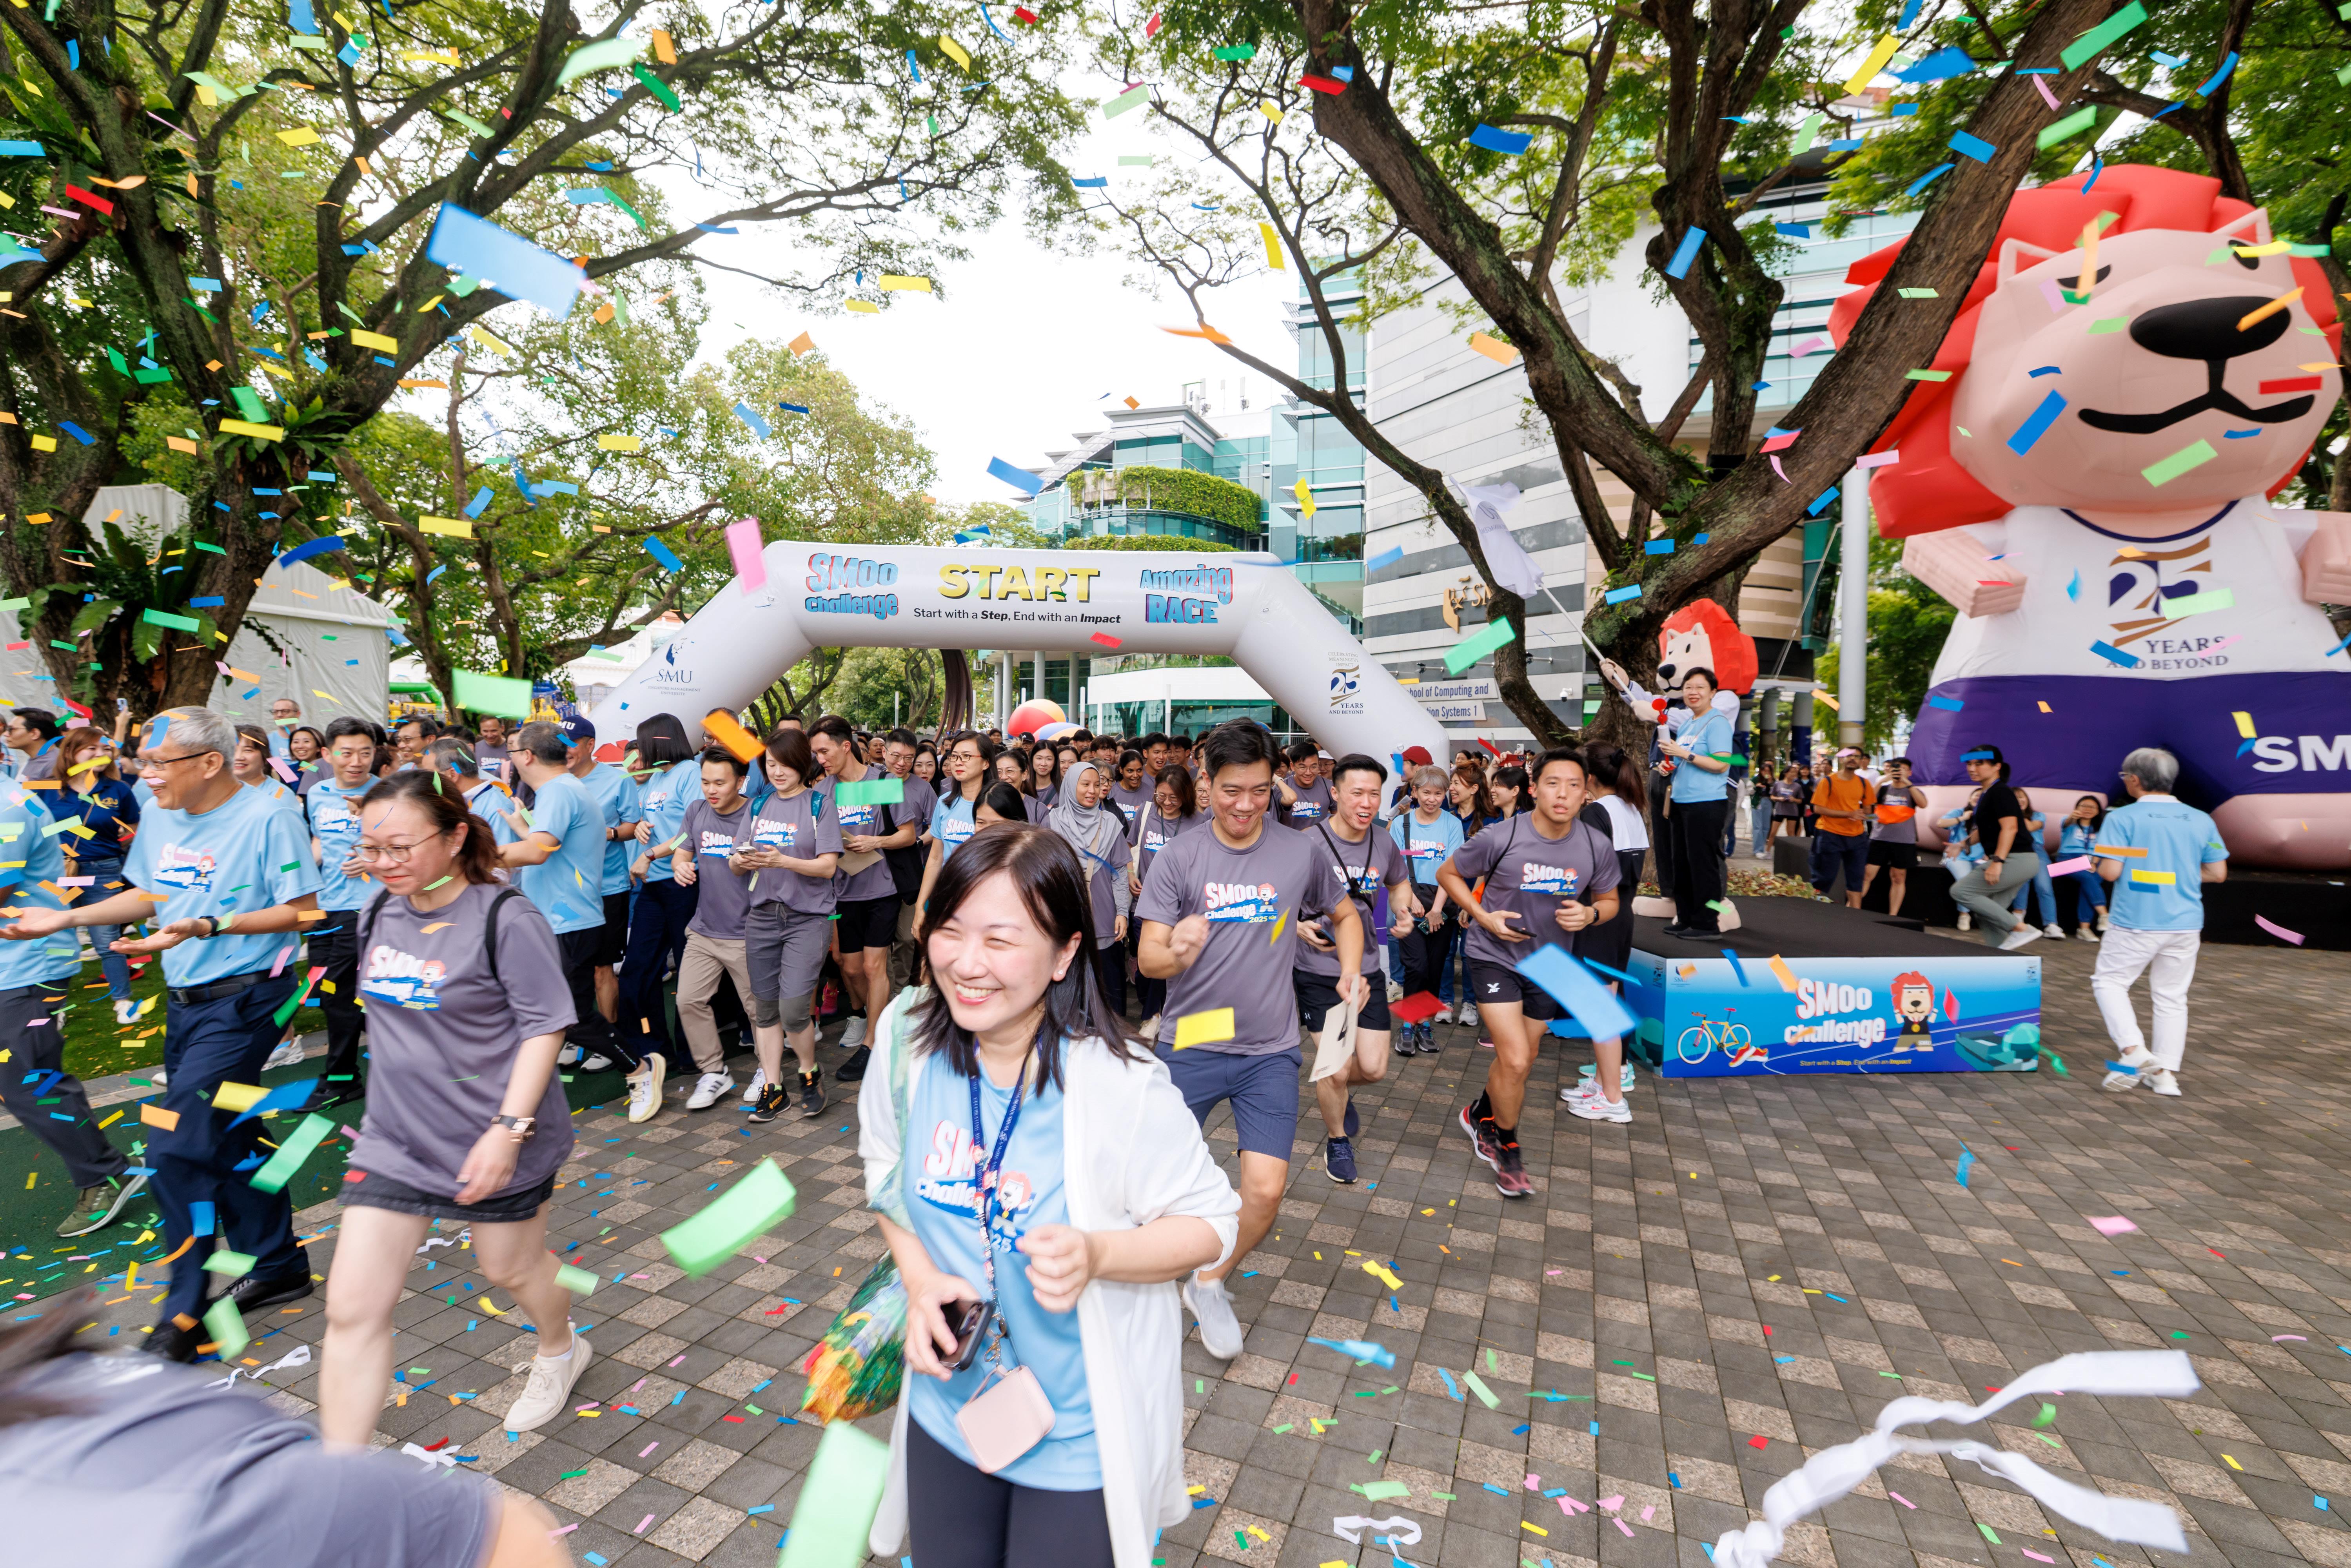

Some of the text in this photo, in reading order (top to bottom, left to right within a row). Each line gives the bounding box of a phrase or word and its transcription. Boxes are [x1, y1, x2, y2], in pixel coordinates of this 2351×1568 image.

[938, 564, 1100, 603] START
[1140, 564, 1233, 605] Amazing
[914, 608, 942, 618] Start
[945, 609, 969, 619] with
[980, 610, 1010, 621] Step,
[1014, 612, 1035, 621] End
[1037, 612, 1061, 622] with
[1080, 613, 1121, 624] Impact
[1145, 594, 1218, 624] RACE
[2151, 656, 2228, 670] BEYOND
[657, 669, 693, 683] SMU
[1426, 687, 1432, 697] of
[1434, 685, 1472, 698] Computing
[1475, 683, 1489, 694] and
[1441, 706, 1471, 719] Systems
[1474, 705, 1477, 716] 1
